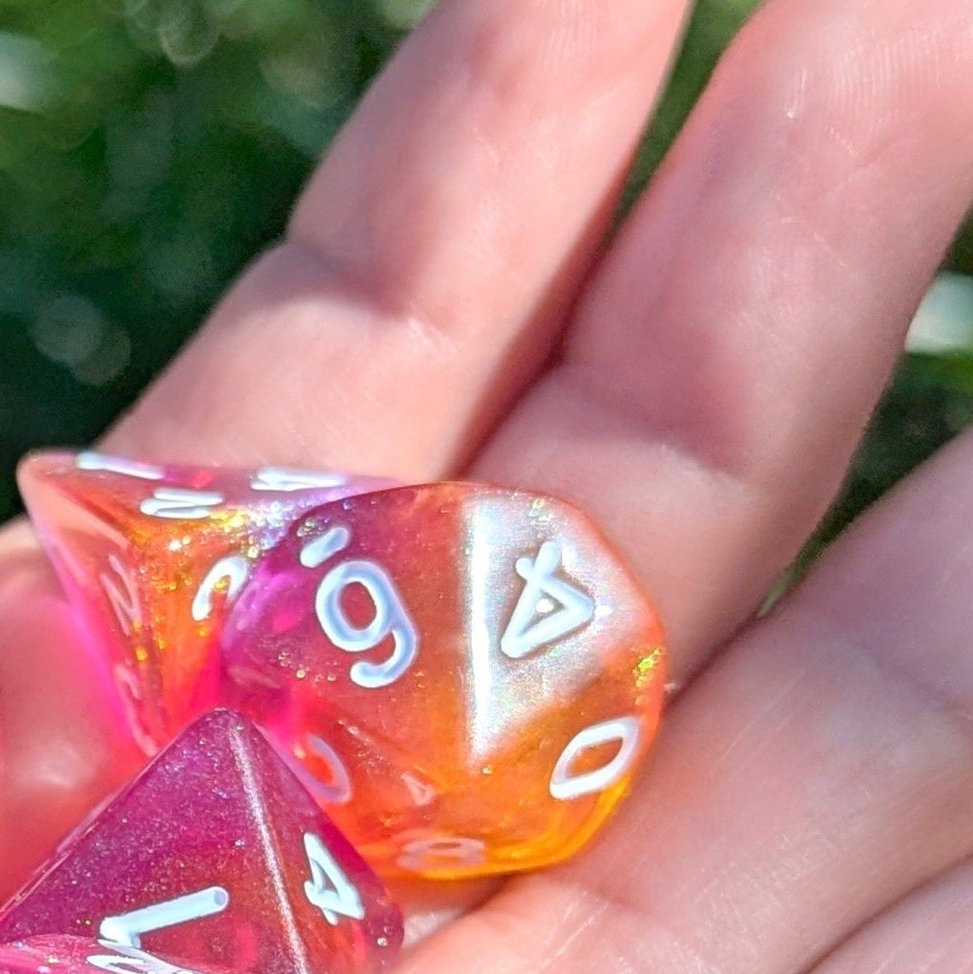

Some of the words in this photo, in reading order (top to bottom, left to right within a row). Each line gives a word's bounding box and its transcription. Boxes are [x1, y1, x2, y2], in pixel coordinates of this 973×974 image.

[500, 541, 597, 658] 4
[549, 716, 640, 799] 0
[304, 832, 365, 925] 4
